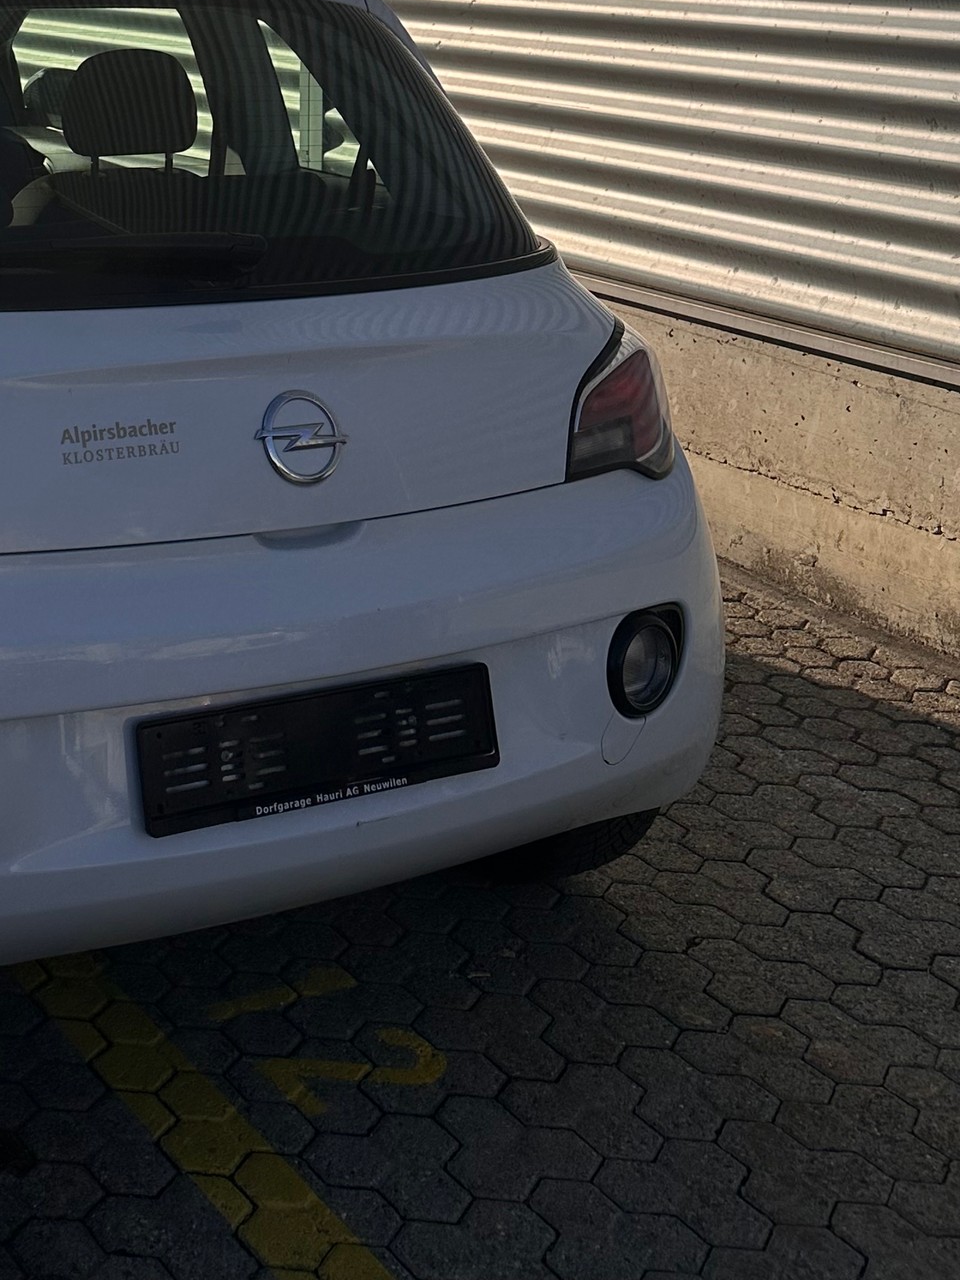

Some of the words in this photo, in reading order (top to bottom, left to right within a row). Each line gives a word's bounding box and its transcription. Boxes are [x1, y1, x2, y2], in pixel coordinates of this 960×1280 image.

[61, 419, 177, 448] Alpirsbacher
[62, 439, 180, 465] KLOSTERBRÄU
[255, 797, 312, 816] Dorfgarage
[316, 789, 343, 803] Hauri
[346, 786, 360, 797] AG
[363, 777, 408, 794] Neuwilen
